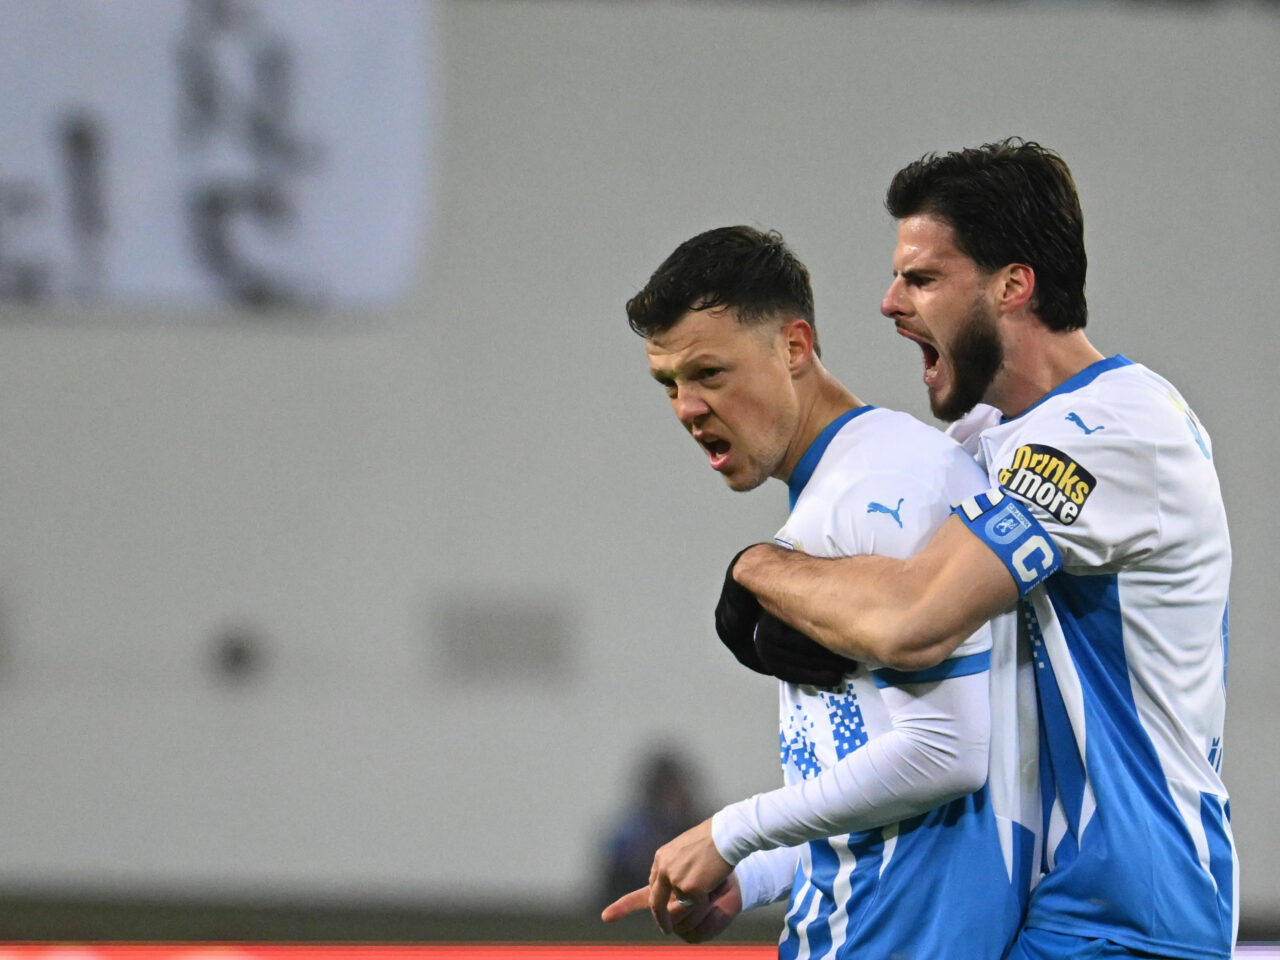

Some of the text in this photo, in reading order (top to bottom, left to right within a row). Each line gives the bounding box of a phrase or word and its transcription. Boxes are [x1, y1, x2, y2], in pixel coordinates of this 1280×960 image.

[1008, 467, 1079, 524] more
[1013, 445, 1090, 505] Drinks
[1012, 535, 1055, 582] C
